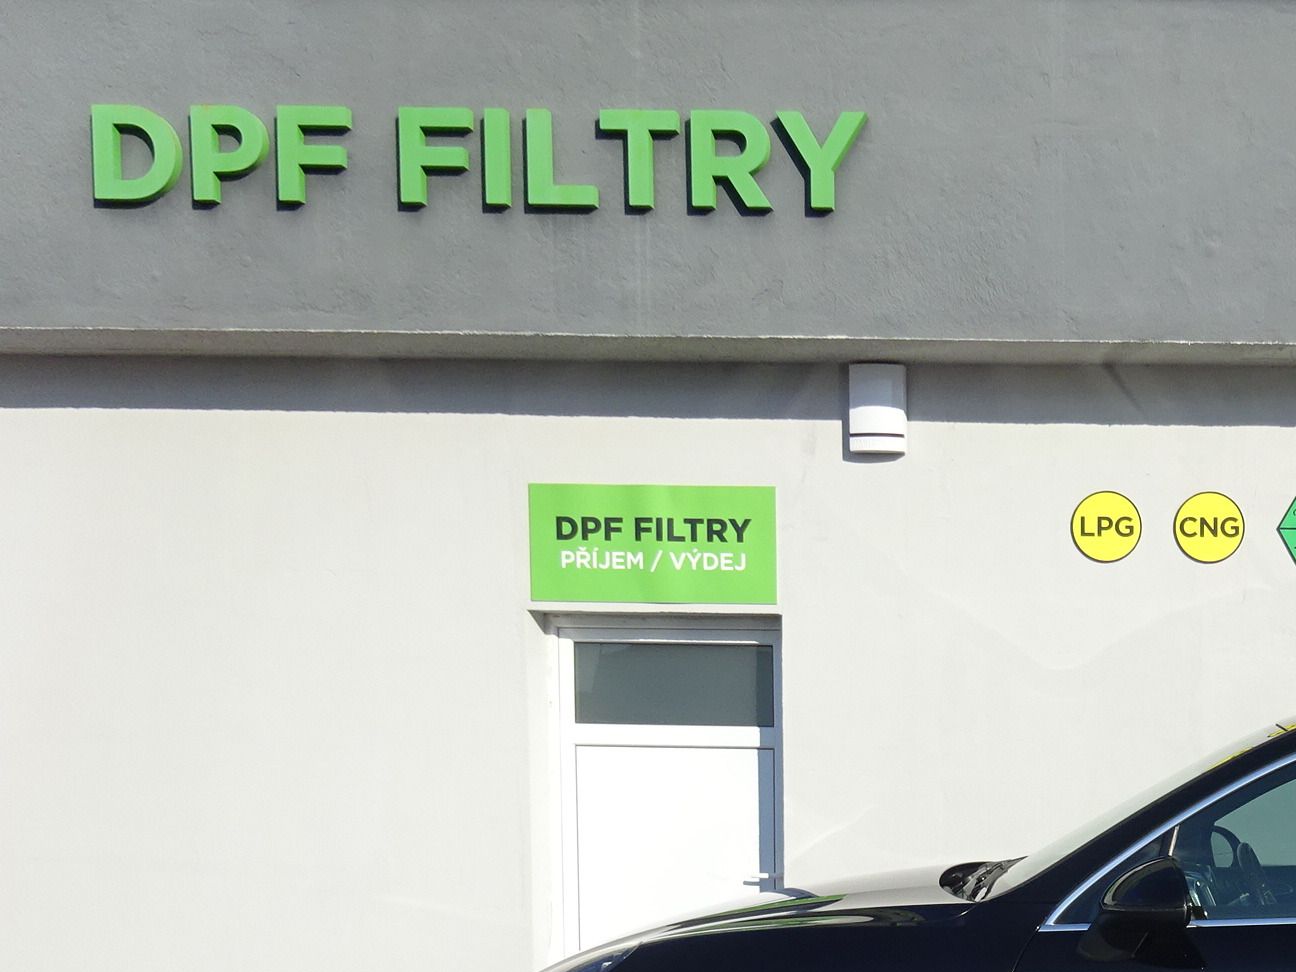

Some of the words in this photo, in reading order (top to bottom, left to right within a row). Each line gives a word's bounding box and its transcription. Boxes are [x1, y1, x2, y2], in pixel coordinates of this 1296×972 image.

[91, 104, 352, 206] DPF
[397, 107, 868, 210] FILTRY
[556, 515, 624, 542] DPF
[634, 516, 752, 543] FILTRY
[1080, 516, 1134, 538] LPG
[1179, 516, 1240, 538] CNG
[561, 547, 644, 570] PŘÍJEM
[650, 550, 663, 573] /
[669, 549, 746, 571] VÝDEJ
